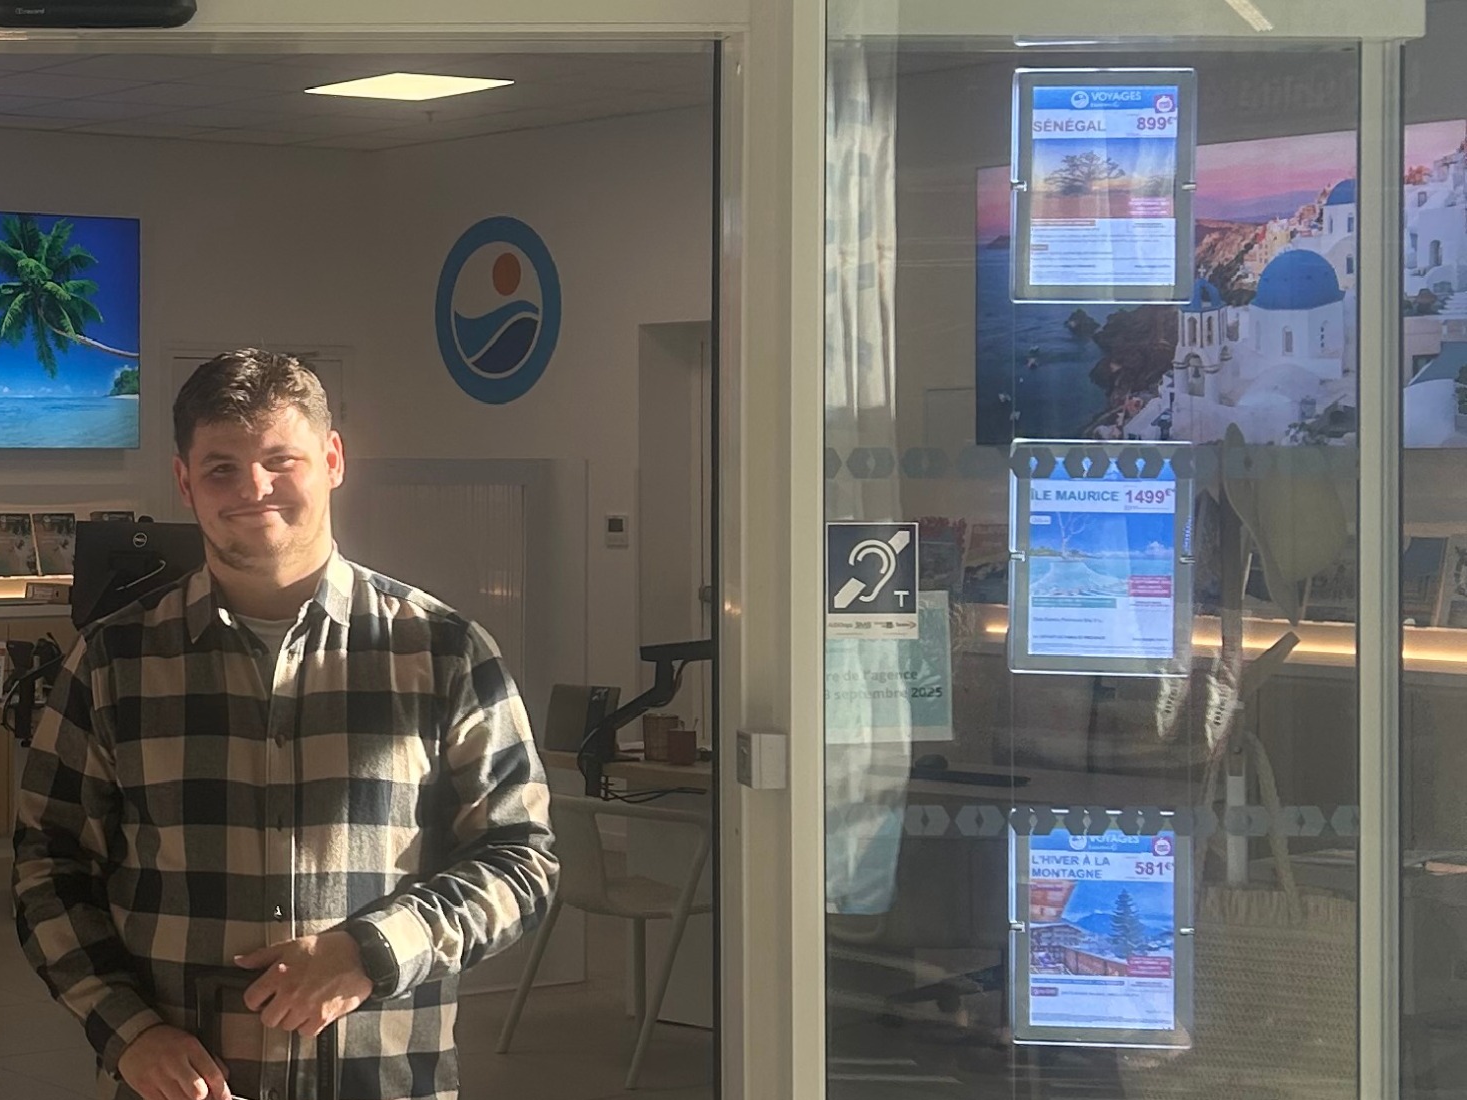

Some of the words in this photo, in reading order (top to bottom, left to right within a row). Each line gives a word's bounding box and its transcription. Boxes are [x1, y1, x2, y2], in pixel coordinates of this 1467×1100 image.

[1091, 91, 1142, 101] VOYAGES
[1033, 118, 1106, 132] SÉNÉGAL
[1055, 488, 1119, 501] MAURICE
[894, 590, 909, 607] T
[911, 687, 943, 698] 2025
[1084, 854, 1091, 866] À
[1095, 856, 1111, 866] LA
[1032, 868, 1103, 879] MONTAGNE
